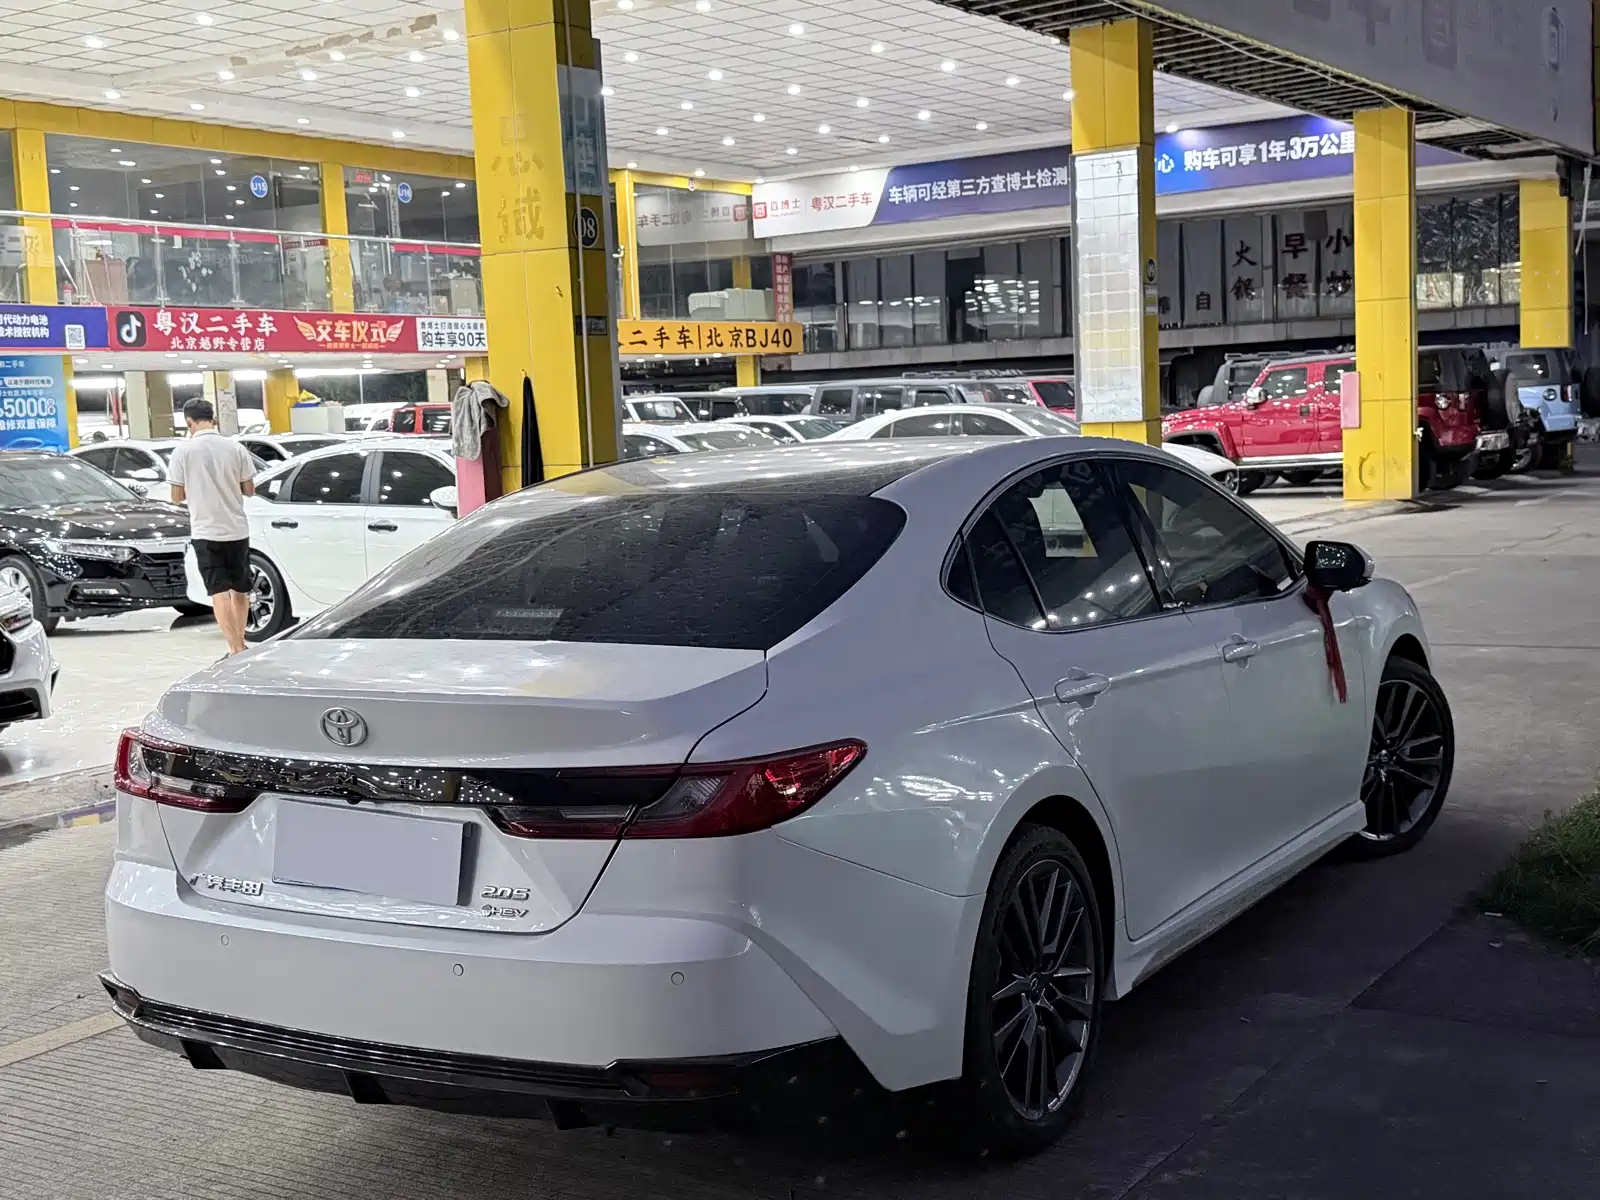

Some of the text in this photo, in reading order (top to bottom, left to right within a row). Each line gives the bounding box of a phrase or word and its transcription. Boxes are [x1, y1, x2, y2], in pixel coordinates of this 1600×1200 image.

[1154, 152, 1175, 174] 心
[888, 165, 1072, 205] 车辆可经第三方查博士检测
[811, 190, 873, 213] 粤汉二手车
[152, 308, 279, 336] 粤汉二手车
[315, 318, 387, 343] 交车仪式
[170, 336, 266, 351] 北京越野专营店
[421, 331, 486, 347] 购车享90天
[617, 325, 694, 350] 二手车
[188, 872, 264, 896] 广汽丰田
[491, 906, 530, 918] HEV
